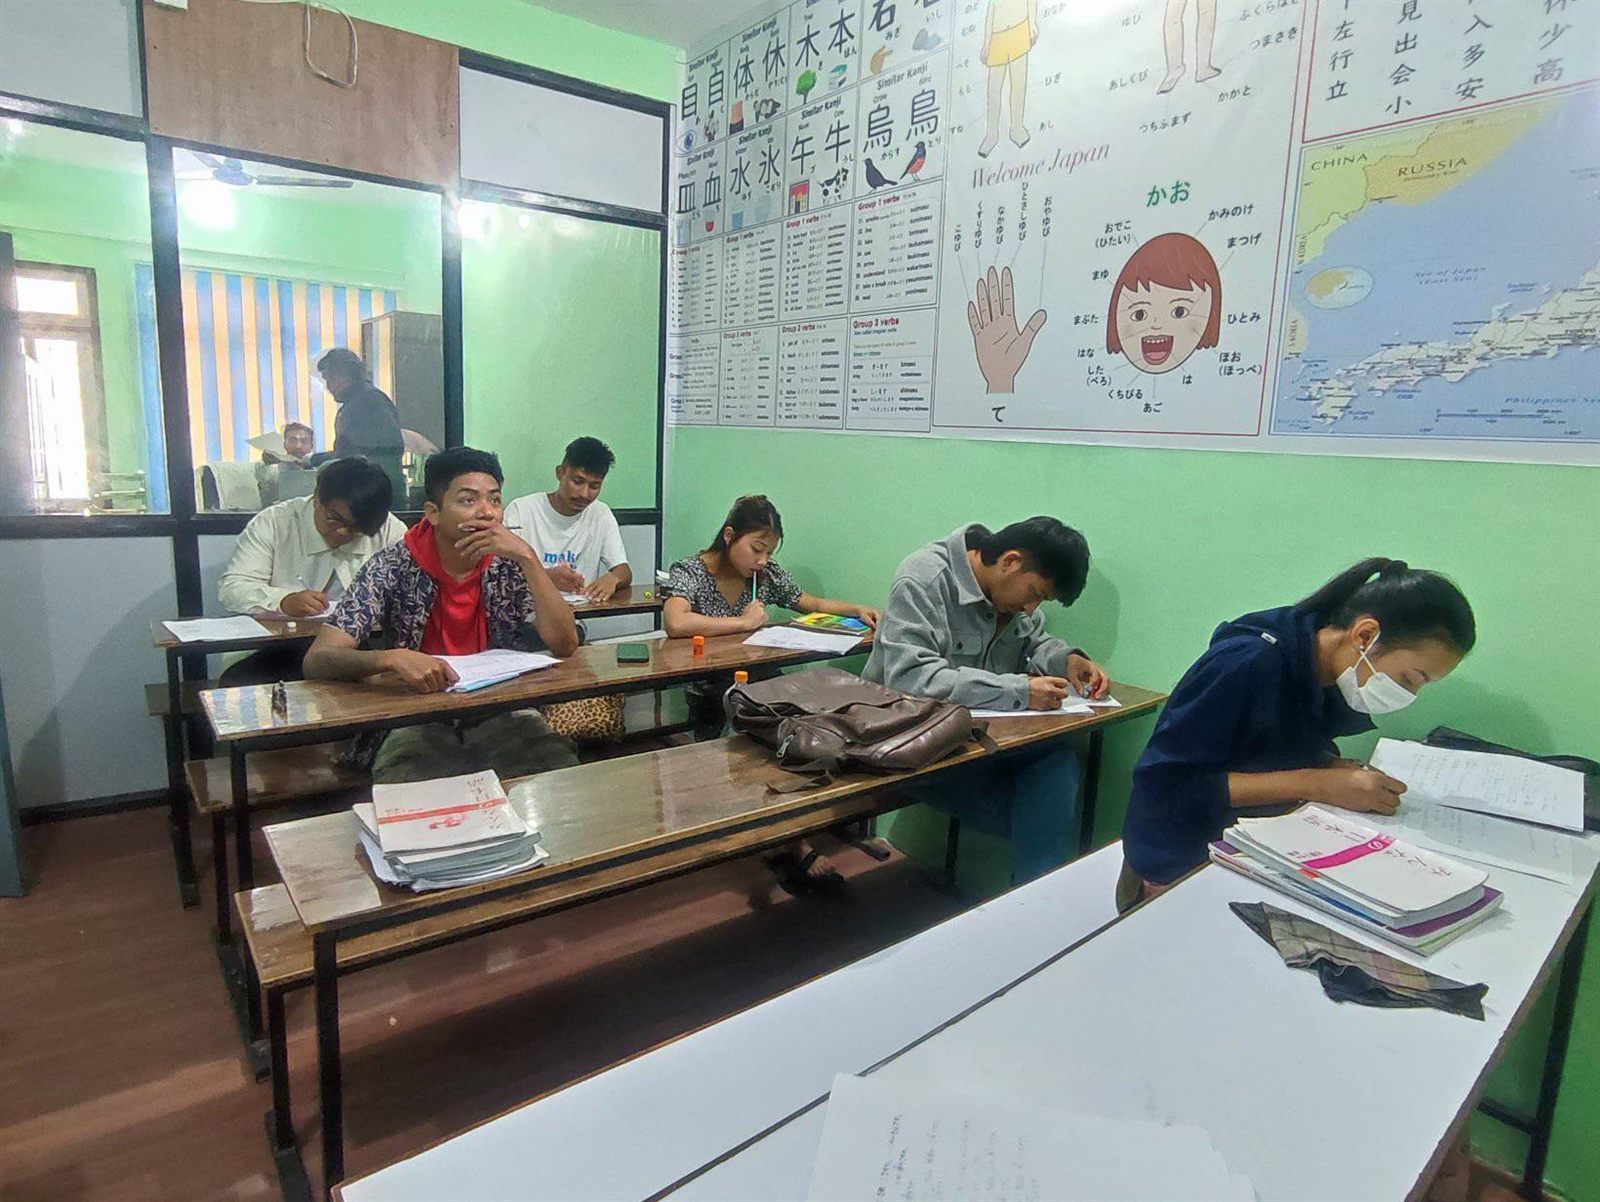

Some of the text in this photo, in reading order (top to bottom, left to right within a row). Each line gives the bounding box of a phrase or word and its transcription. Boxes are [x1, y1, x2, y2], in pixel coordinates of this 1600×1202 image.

[1240, 0, 1298, 21] ふくらは
[828, 8, 855, 54] 本
[1249, 26, 1298, 50] つまさき
[795, 24, 820, 67] 木
[763, 36, 786, 82] 休
[709, 66, 724, 107] 自
[733, 54, 754, 98] 体
[877, 61, 929, 91] Similar Kanji
[682, 82, 698, 121] 目
[1218, 84, 1252, 103] かかと
[906, 89, 940, 141] 鳥
[824, 119, 851, 164] 牛
[758, 144, 780, 185] 氷
[791, 136, 815, 176] 午
[973, 144, 1110, 189] Welcome Japan
[1311, 152, 1368, 171] CHINA
[1398, 157, 1468, 177] RUSSIA
[730, 155, 751, 195] 水
[676, 182, 696, 214] 皿
[703, 171, 722, 208] 血
[1146, 180, 1191, 207] かお
[1018, 182, 1029, 241] ひとさしゆび
[1042, 197, 1053, 237] おやゆび
[1208, 203, 1255, 221] かみのけ
[975, 201, 983, 248] くすりゆび
[996, 206, 1005, 245] なかゆび
[1104, 220, 1132, 234] おでこ
[1095, 233, 1132, 249] (ひたい)
[1227, 232, 1262, 249] まつげ
[1092, 269, 1109, 281] まゆ
[853, 320, 873, 329] Group
[880, 317, 899, 326] verbs
[1073, 314, 1099, 326] まぶた
[1227, 312, 1261, 325] ひとみ
[1077, 348, 1095, 358] はな
[1218, 351, 1242, 363] ほお
[1088, 365, 1105, 375] した
[1182, 375, 1193, 385] は
[1107, 389, 1144, 400] くちびる
[1143, 401, 1164, 413] あご
[991, 405, 1006, 422] て
